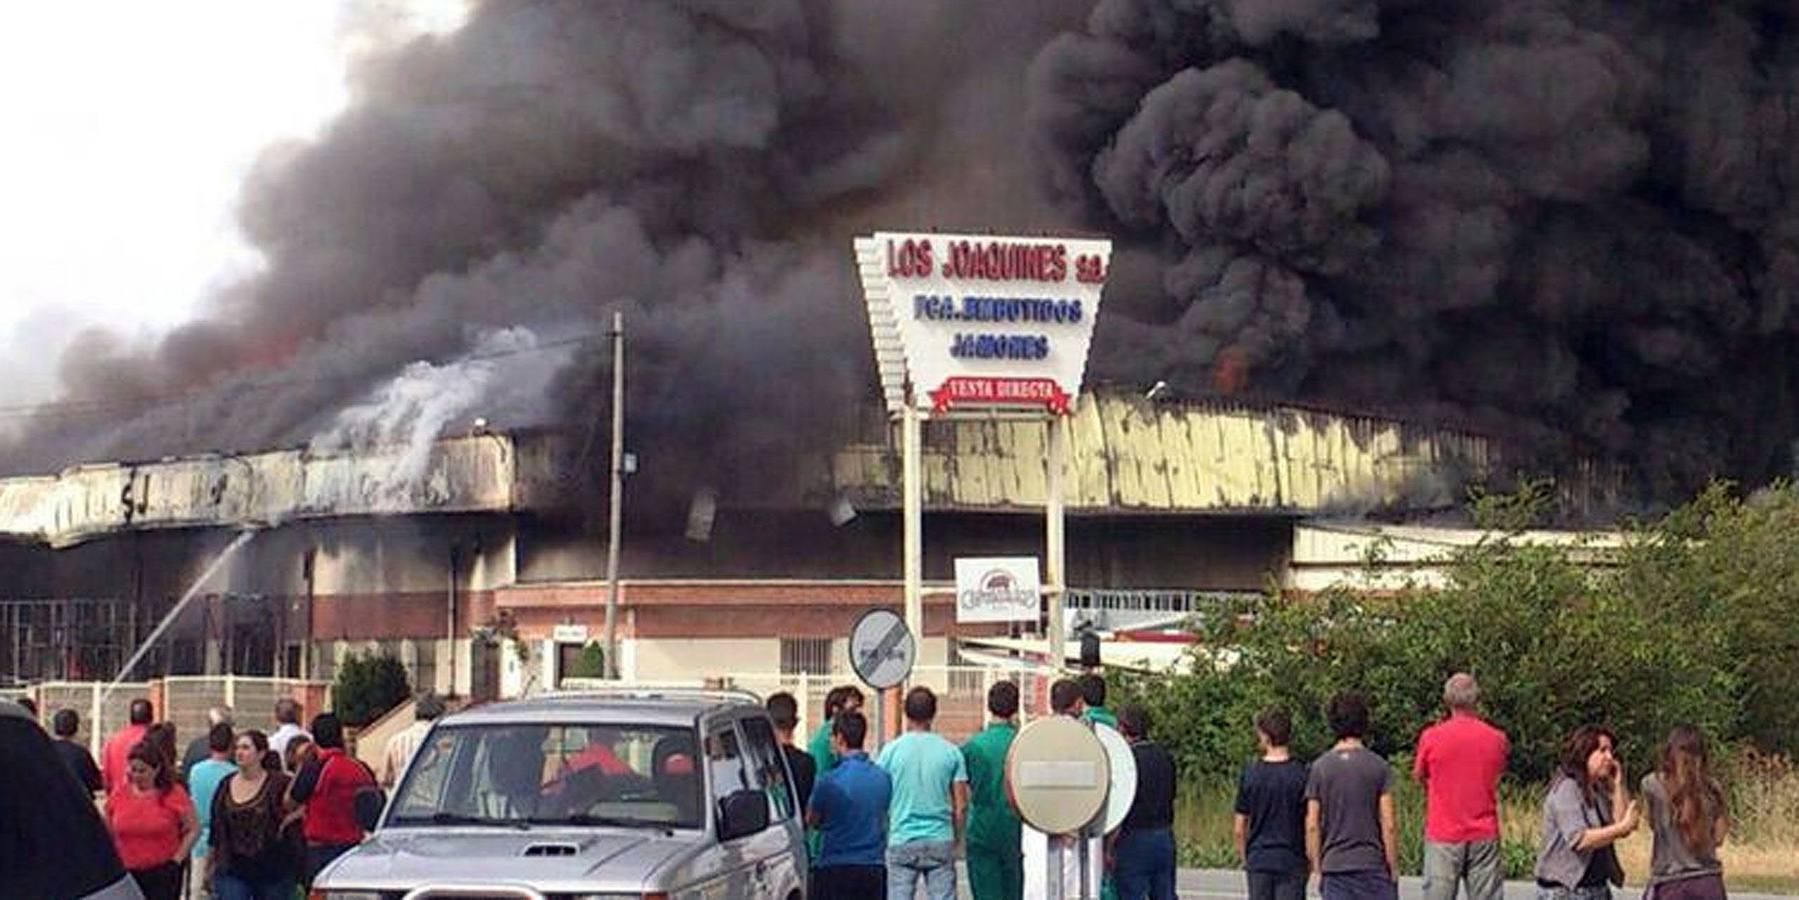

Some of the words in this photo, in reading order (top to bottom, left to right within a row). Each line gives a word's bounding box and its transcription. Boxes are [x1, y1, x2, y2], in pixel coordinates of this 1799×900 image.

[888, 239, 933, 278] LOS
[942, 240, 1066, 282] JOAQUINES
[949, 332, 1048, 360] JAMONES
[949, 379, 993, 398] VENTA
[995, 380, 1053, 398] DIRECTA
